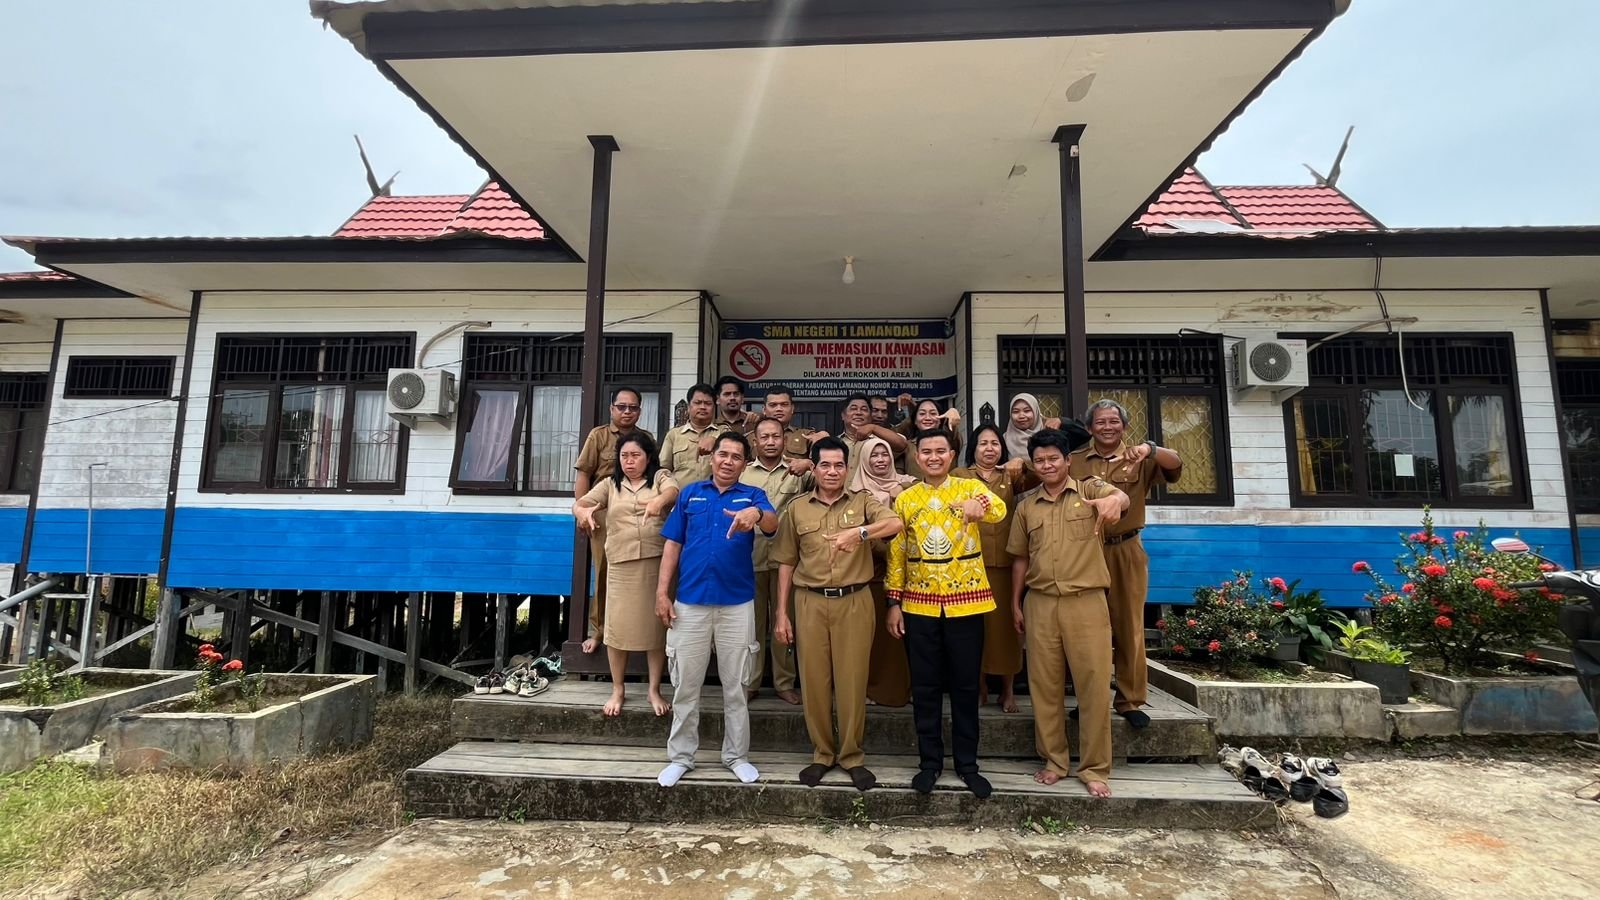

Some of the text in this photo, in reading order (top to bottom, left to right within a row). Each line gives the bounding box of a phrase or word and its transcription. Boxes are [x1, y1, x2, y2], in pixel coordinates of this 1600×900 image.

[763, 325, 919, 337] SMA NEGERI 1 LAMANDAU
[781, 342, 946, 355] ANDA MEMASUKI KAWASAN
[814, 357, 913, 369] TANPA ROKOK !!!
